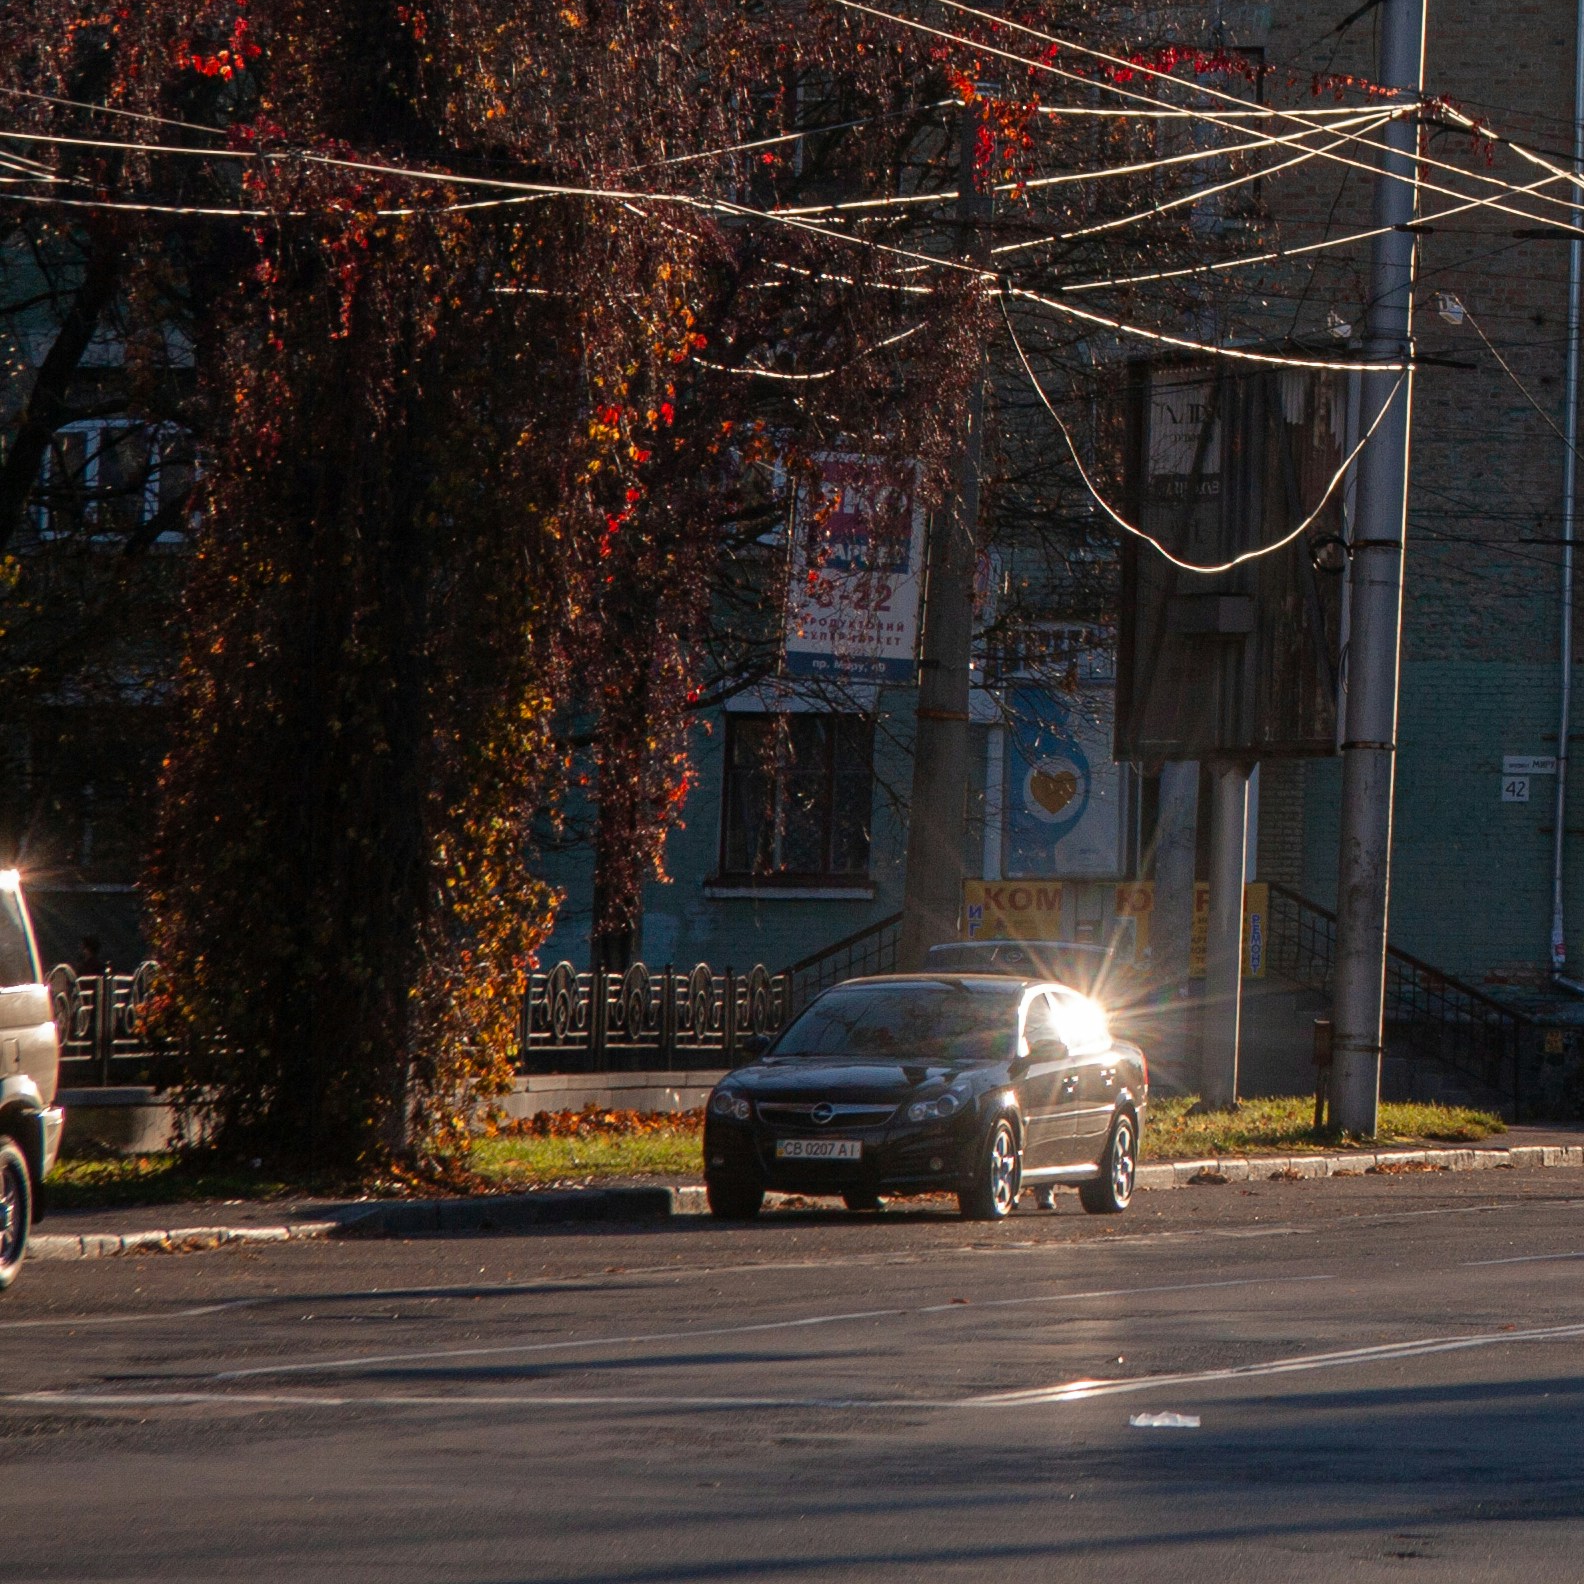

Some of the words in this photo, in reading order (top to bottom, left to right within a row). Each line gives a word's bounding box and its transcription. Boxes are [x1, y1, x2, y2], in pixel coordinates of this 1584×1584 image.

[1505, 780, 1526, 798] 42
[1251, 913, 1262, 974] РЕМОНТ
[784, 1142, 802, 1156] CB
[805, 1142, 835, 1156] 0207
